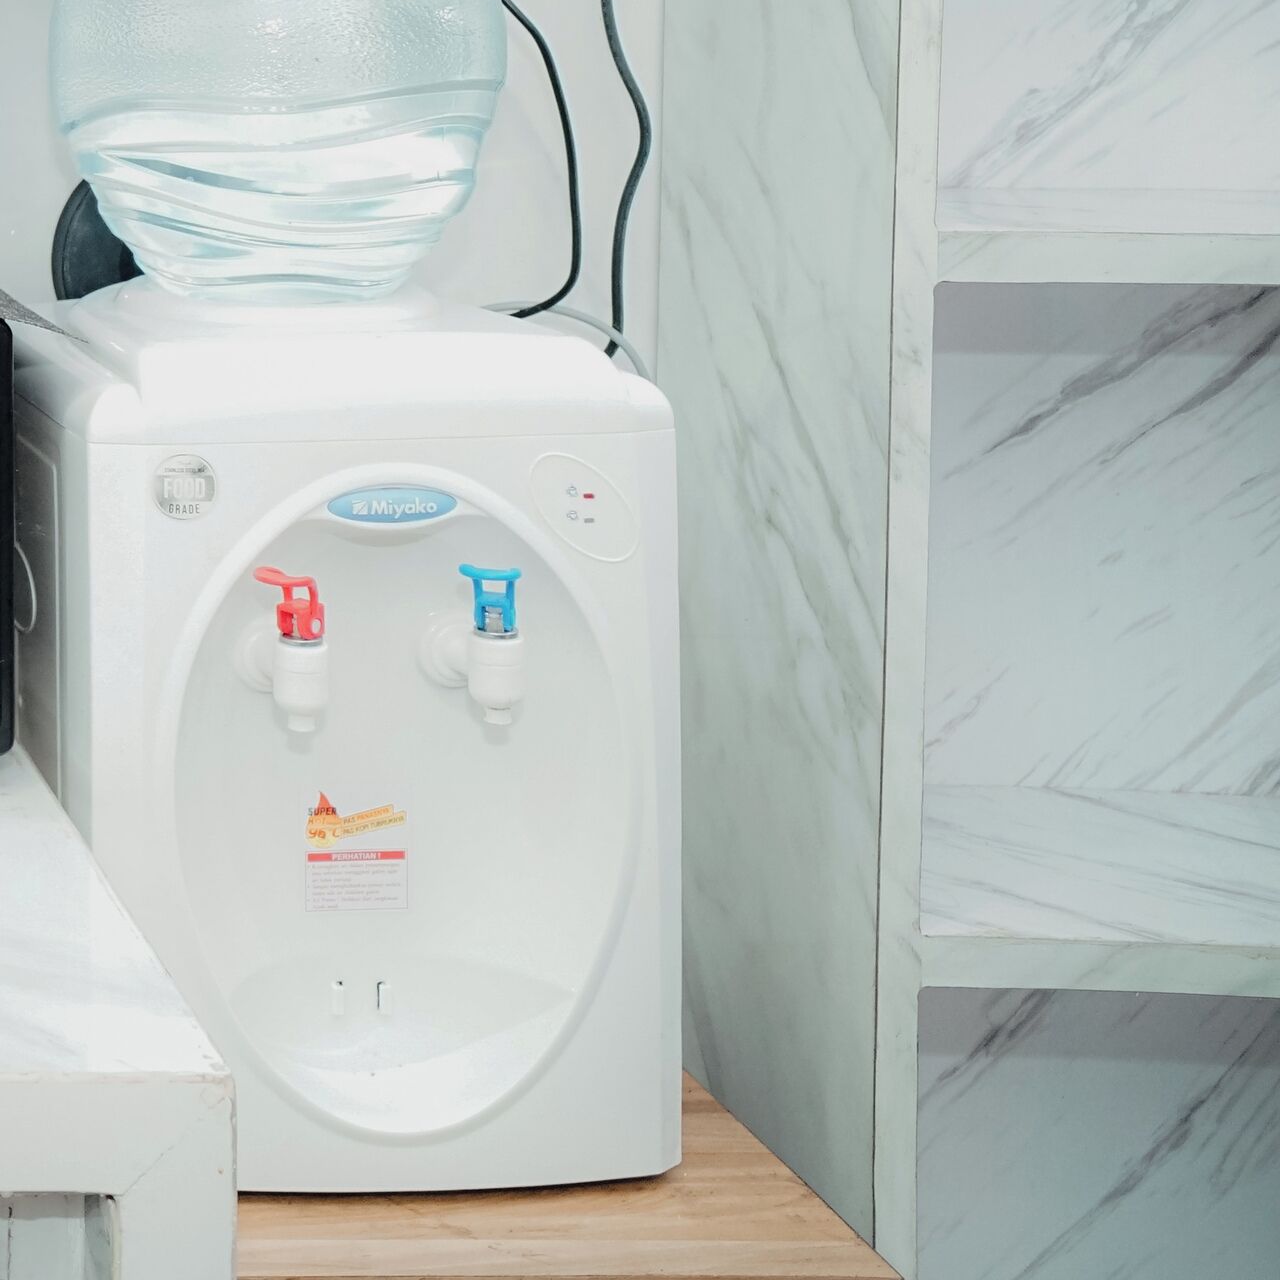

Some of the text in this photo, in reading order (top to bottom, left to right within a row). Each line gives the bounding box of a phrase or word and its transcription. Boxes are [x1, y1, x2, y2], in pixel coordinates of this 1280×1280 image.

[163, 477, 205, 499] FOOD
[168, 503, 200, 514] GRADE
[371, 497, 438, 519] Miyako
[308, 807, 337, 816] SUPER
